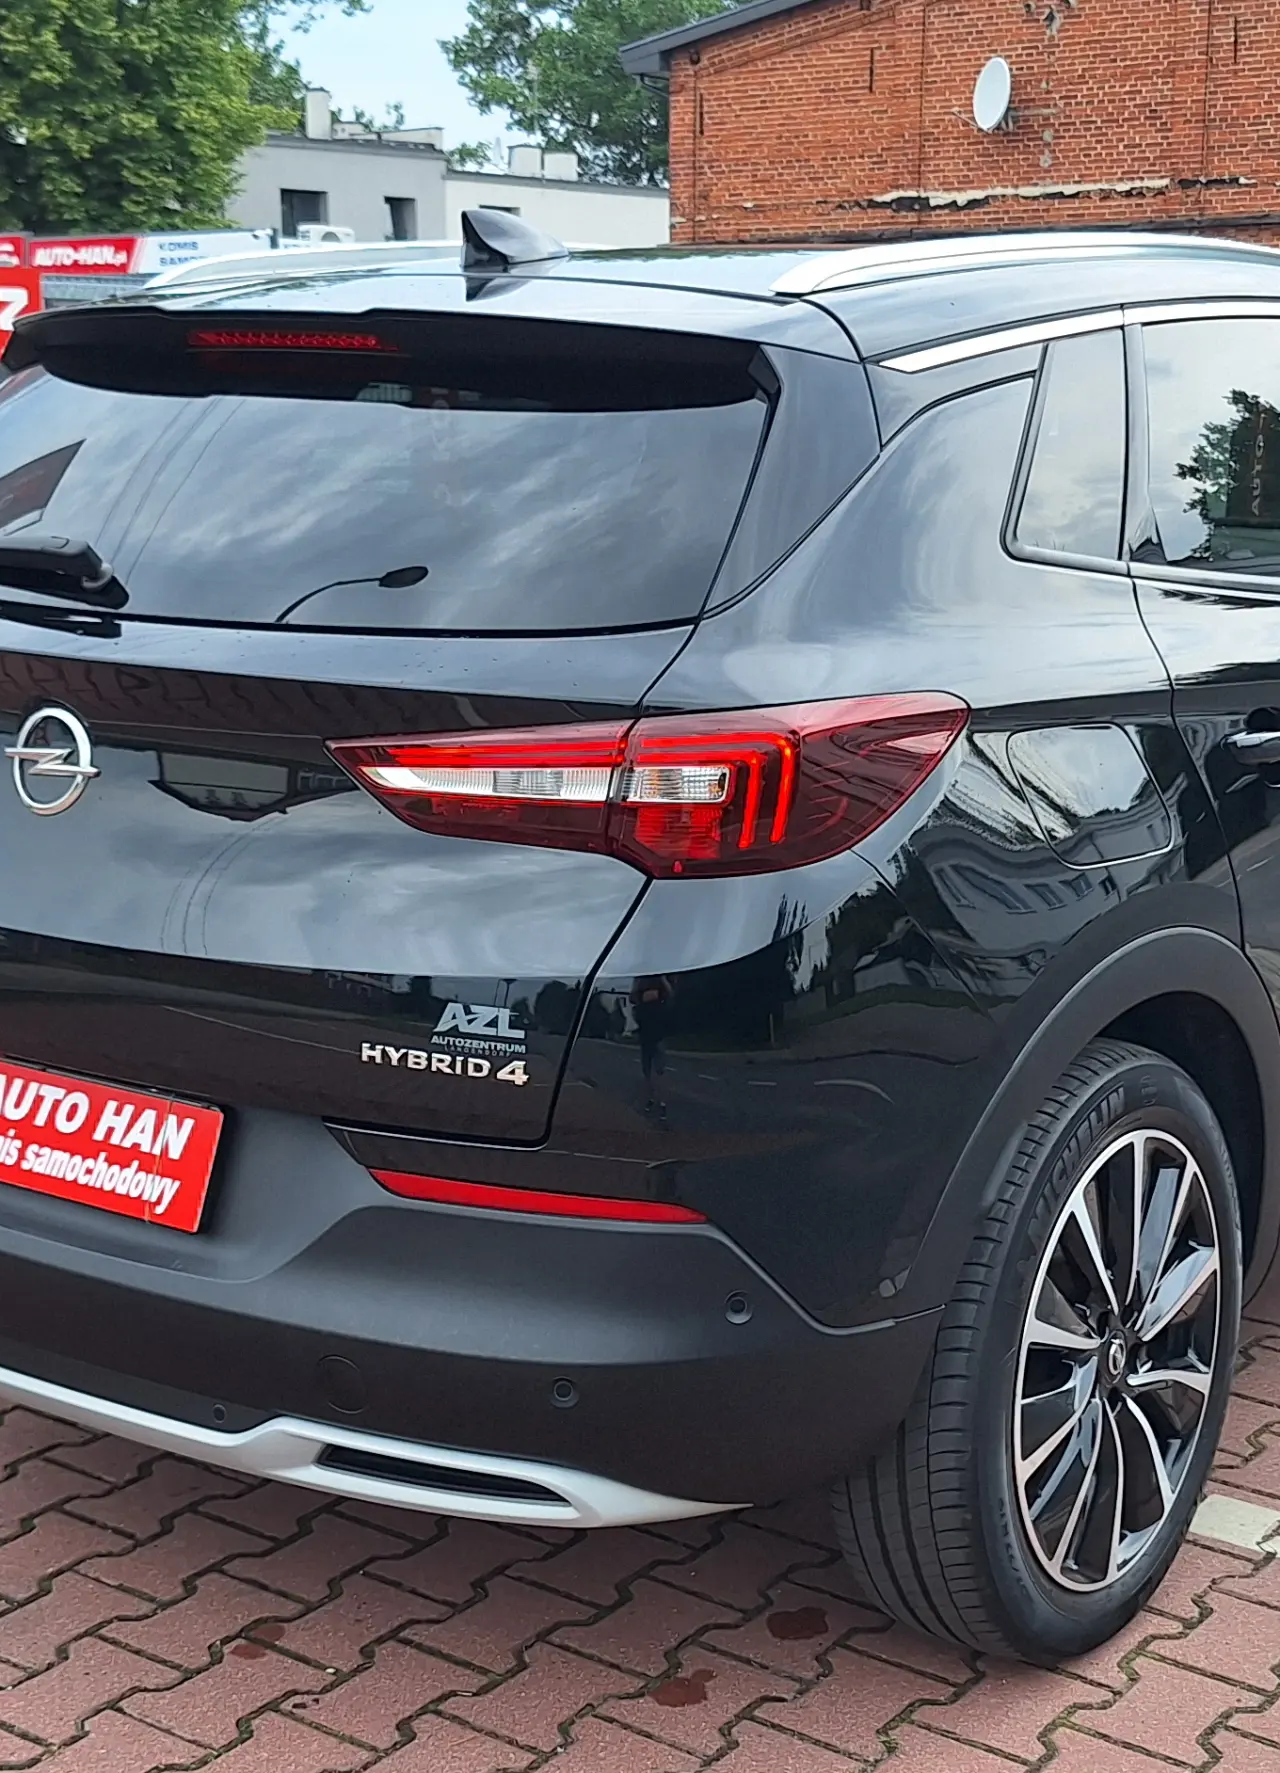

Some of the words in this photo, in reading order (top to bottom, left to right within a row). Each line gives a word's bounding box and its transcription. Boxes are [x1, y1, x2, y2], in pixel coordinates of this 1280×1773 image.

[433, 1002, 525, 1039] AZL
[361, 1042, 491, 1078] HYBRID
[496, 1060, 529, 1086] 4
[431, 1034, 526, 1054] AUTOZENTRUM
[92, 1099, 195, 1160] HAN
[20, 1141, 180, 1215] samochodowy
